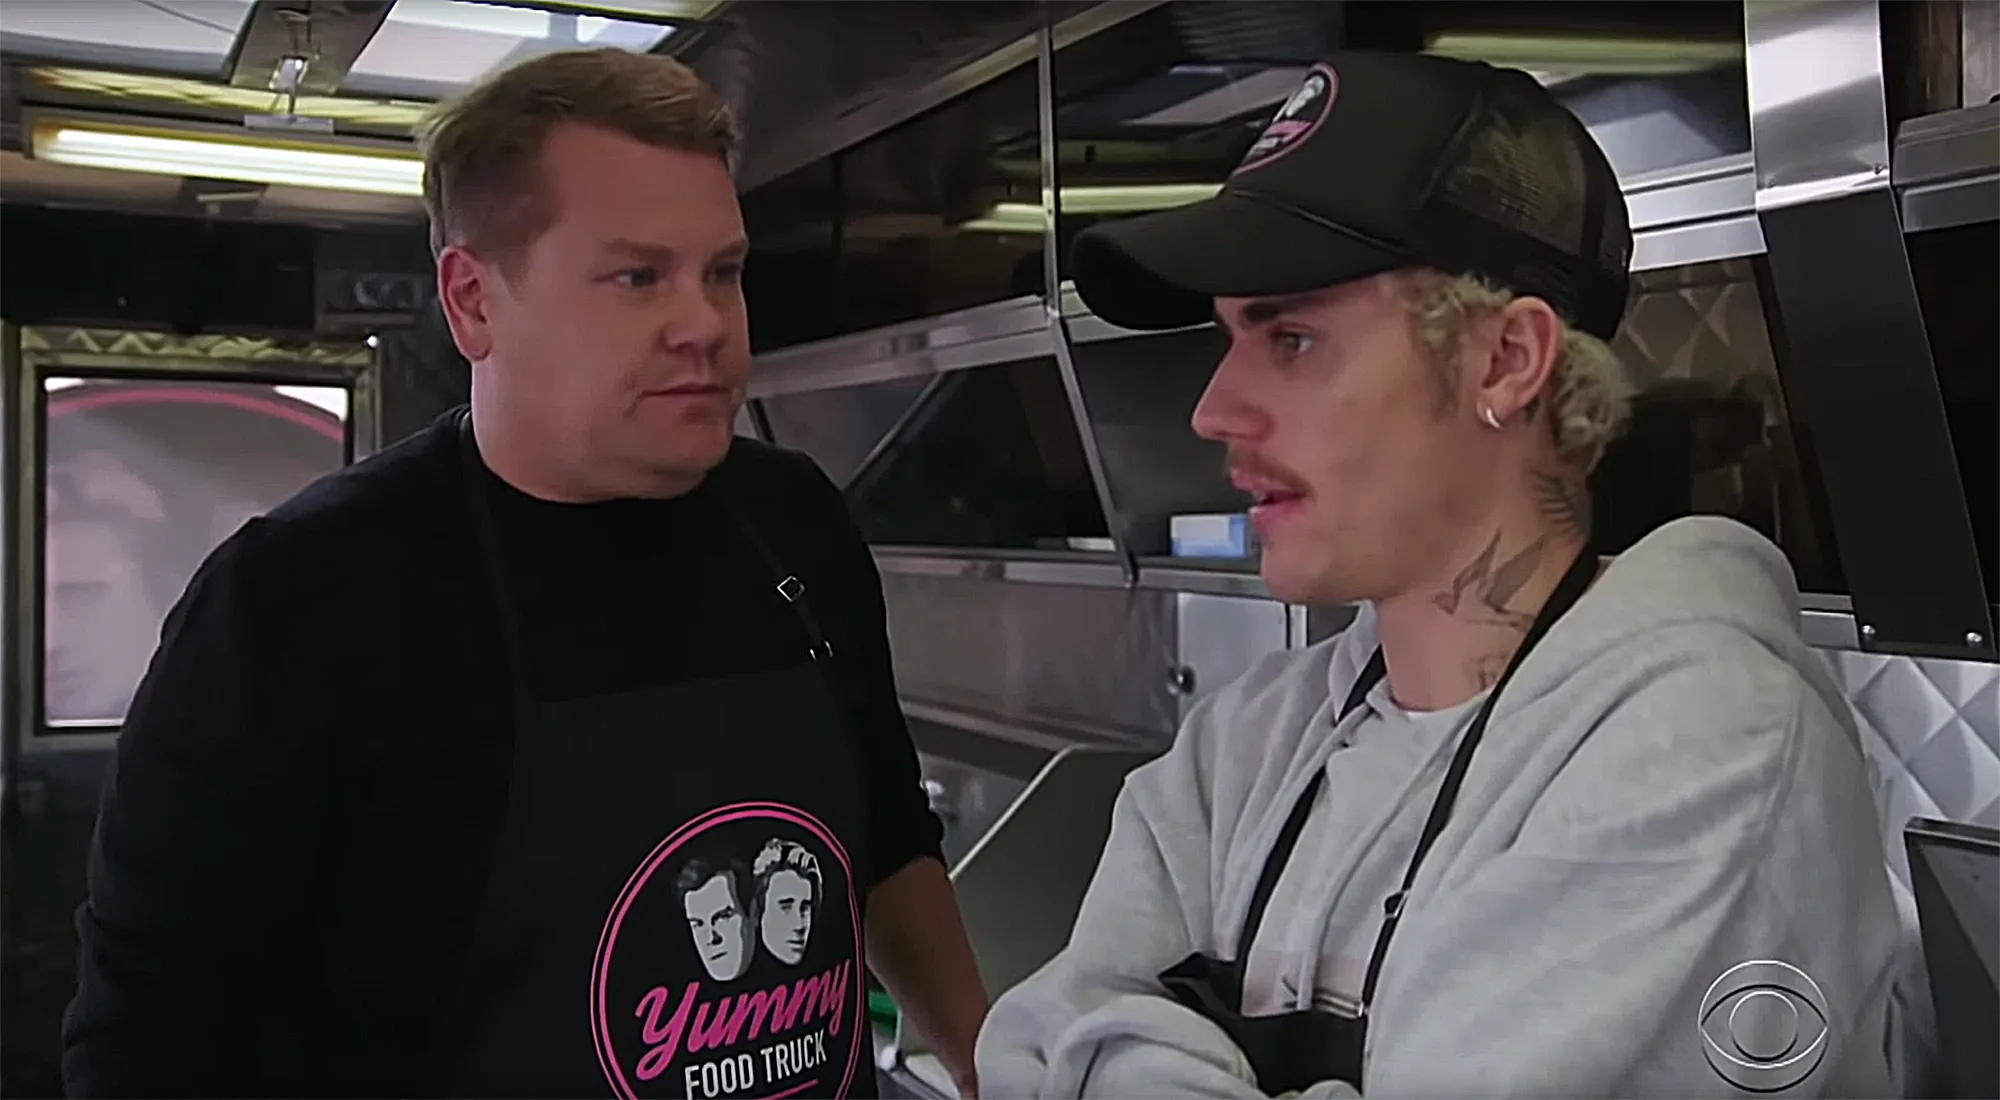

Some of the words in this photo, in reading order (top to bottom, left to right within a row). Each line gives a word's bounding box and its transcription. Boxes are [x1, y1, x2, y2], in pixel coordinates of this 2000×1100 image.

[635, 960, 850, 1080] Yummy
[685, 1054, 753, 1100] FOOD
[761, 1029, 827, 1082] TRUCK
